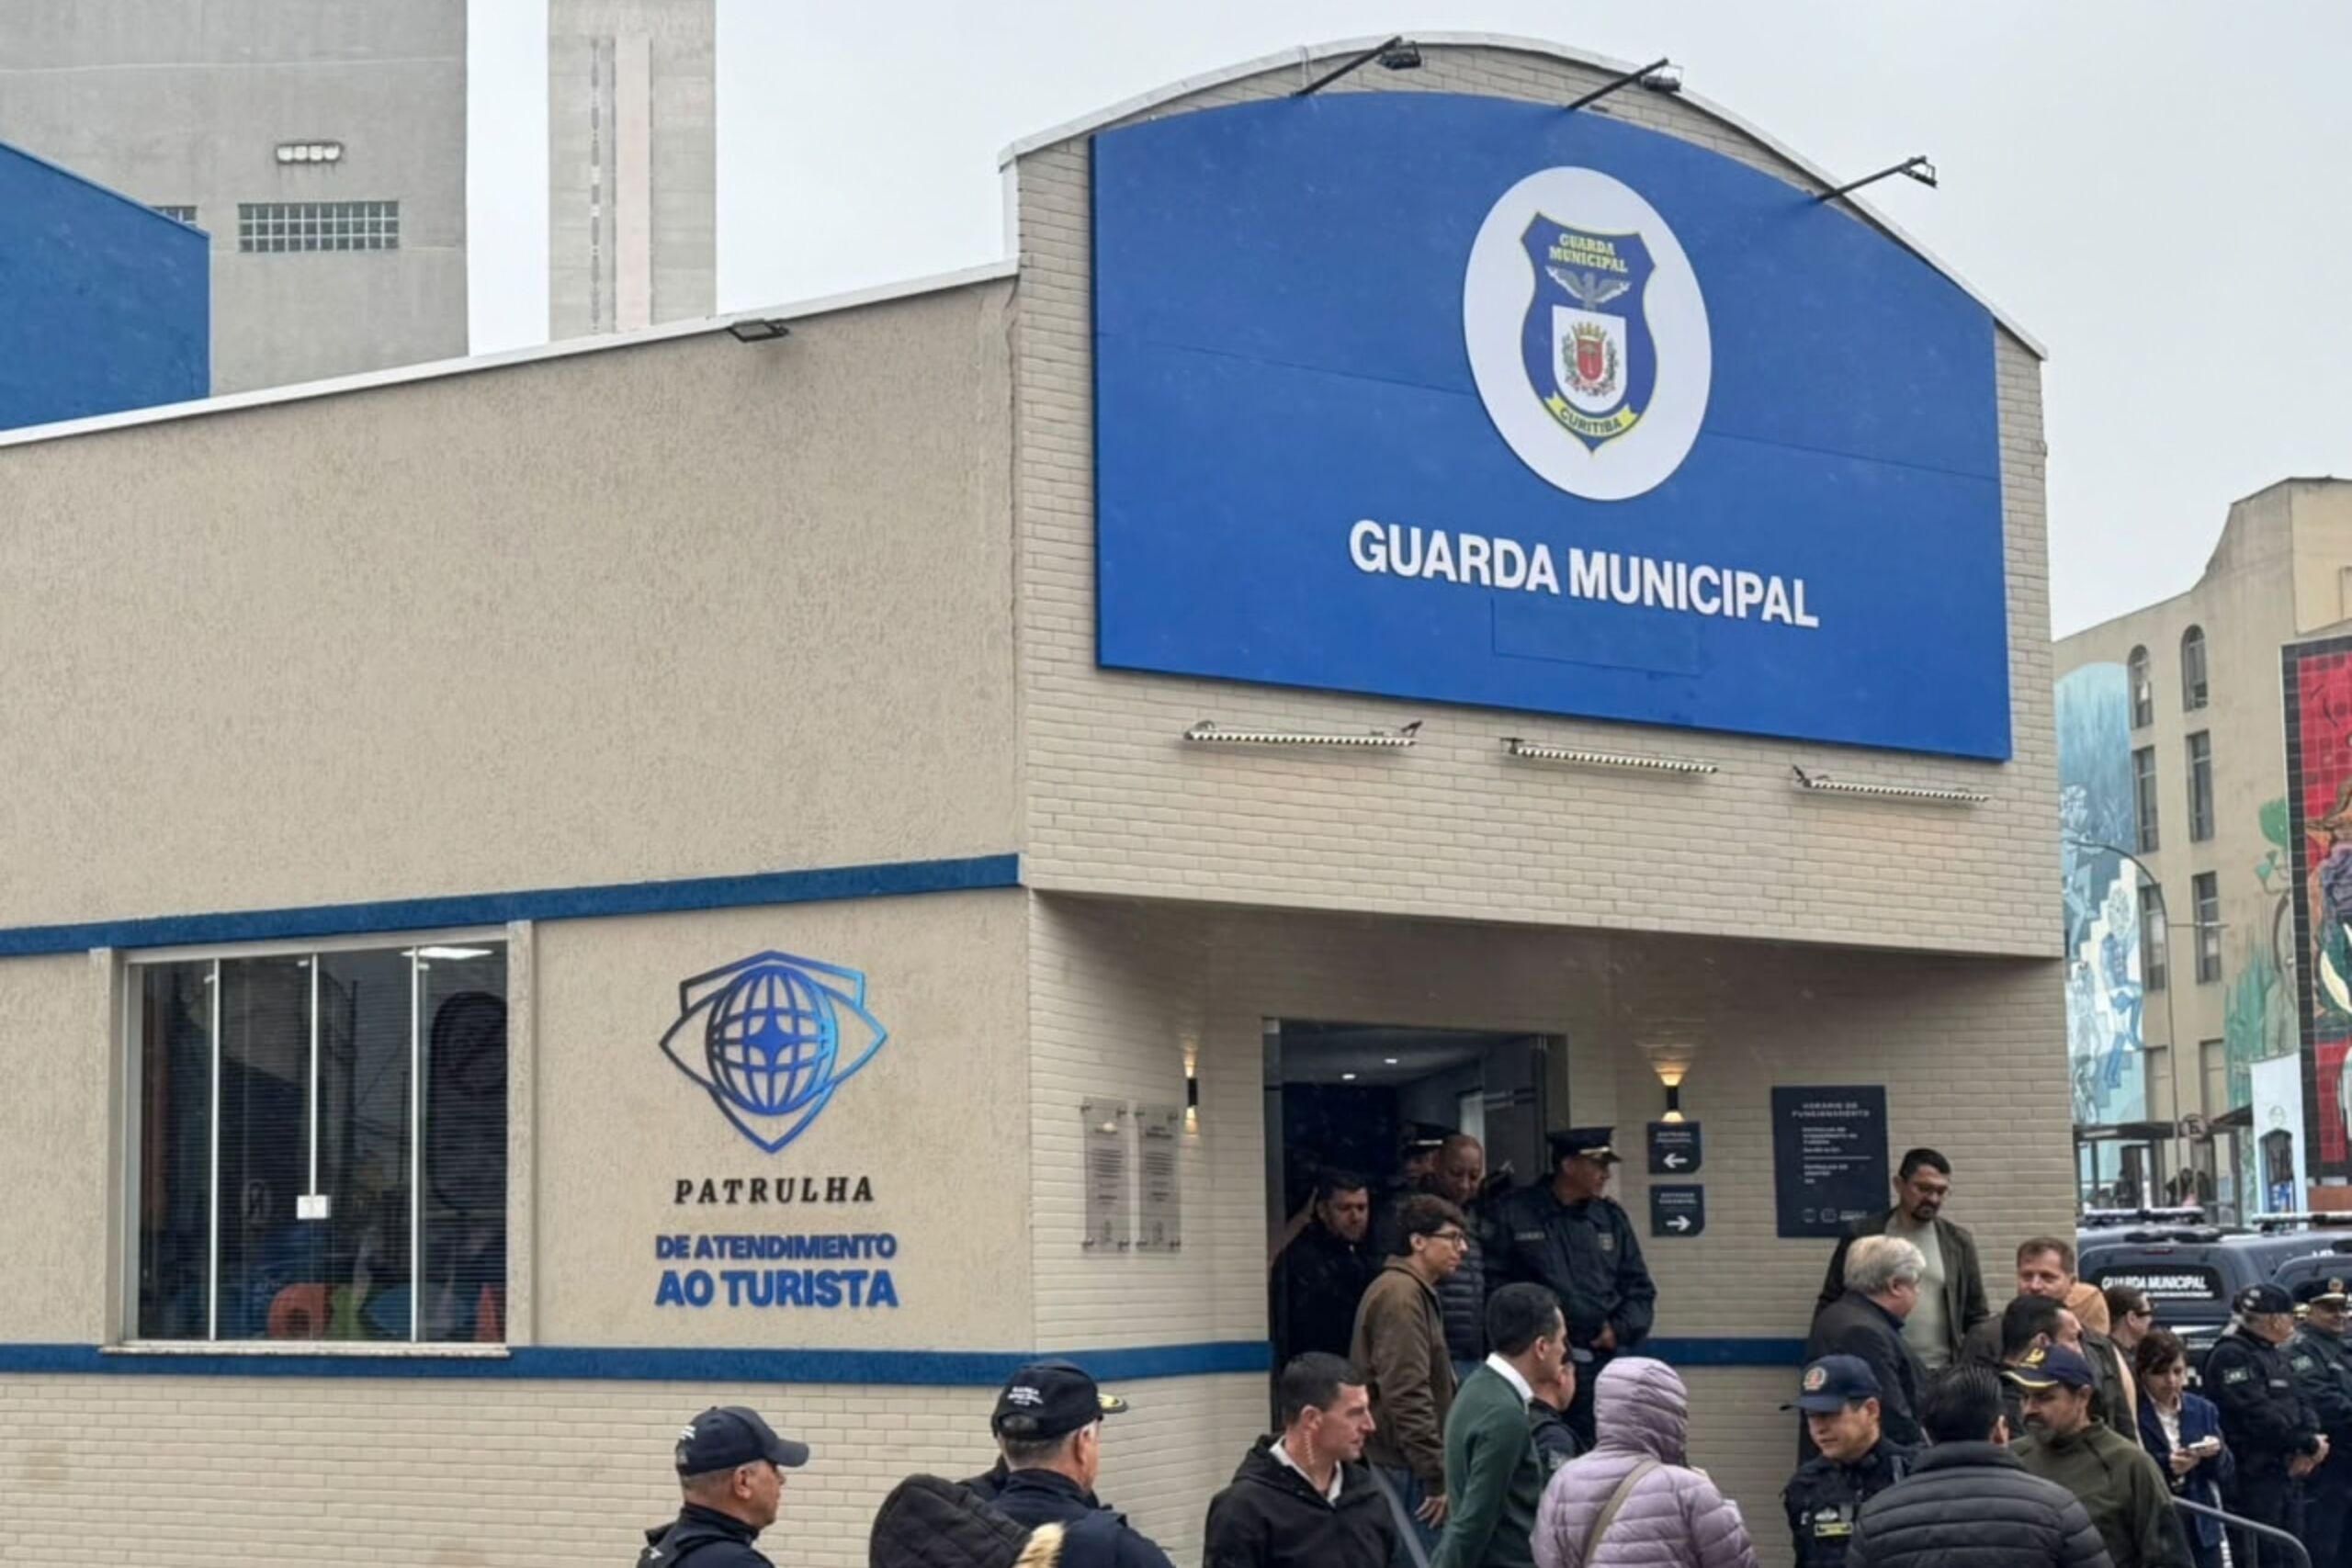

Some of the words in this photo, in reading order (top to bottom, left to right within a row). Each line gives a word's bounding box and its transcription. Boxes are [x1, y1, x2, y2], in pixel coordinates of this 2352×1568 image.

[1559, 233, 1615, 257] GUARDA
[1549, 245, 1629, 274] MUNICIPAL
[1560, 406, 1623, 434] CURITIBA
[1349, 519, 1560, 595] GUARDA
[1568, 547, 1820, 628] MUNICIPAL
[673, 1176, 875, 1205] PATRULHA
[655, 1235, 691, 1260] DE
[694, 1233, 898, 1260] ATENDIMENTO
[654, 1269, 715, 1307] AO
[719, 1269, 899, 1308] TURISTA
[2148, 1275, 2207, 1291] MUNICIPAL
